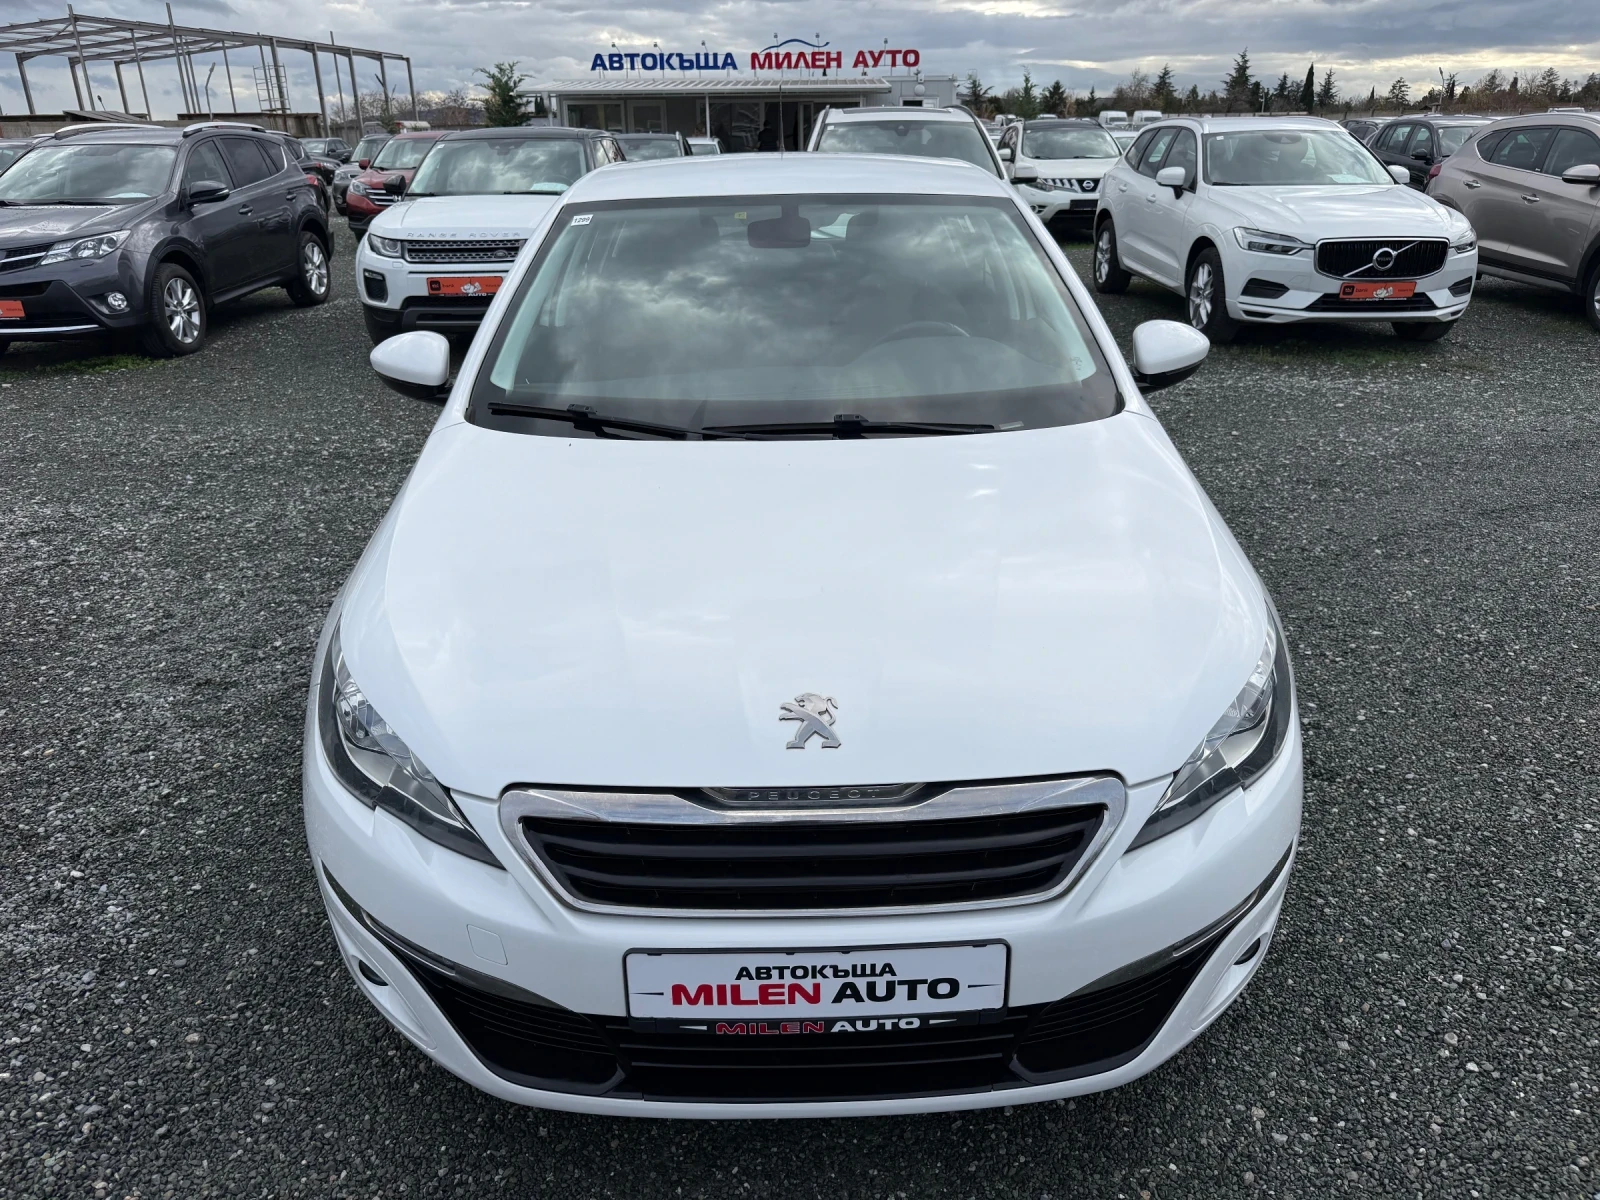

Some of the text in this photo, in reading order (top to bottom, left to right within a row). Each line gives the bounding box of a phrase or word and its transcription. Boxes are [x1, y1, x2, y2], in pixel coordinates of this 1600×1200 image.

[751, 51, 842, 70] МИЛЕН
[852, 49, 920, 68] АУТО
[749, 789, 880, 800] PEUGEOT
[671, 977, 960, 1006] MILEN AUTO
[716, 1017, 921, 1035] MILEN AUTO
